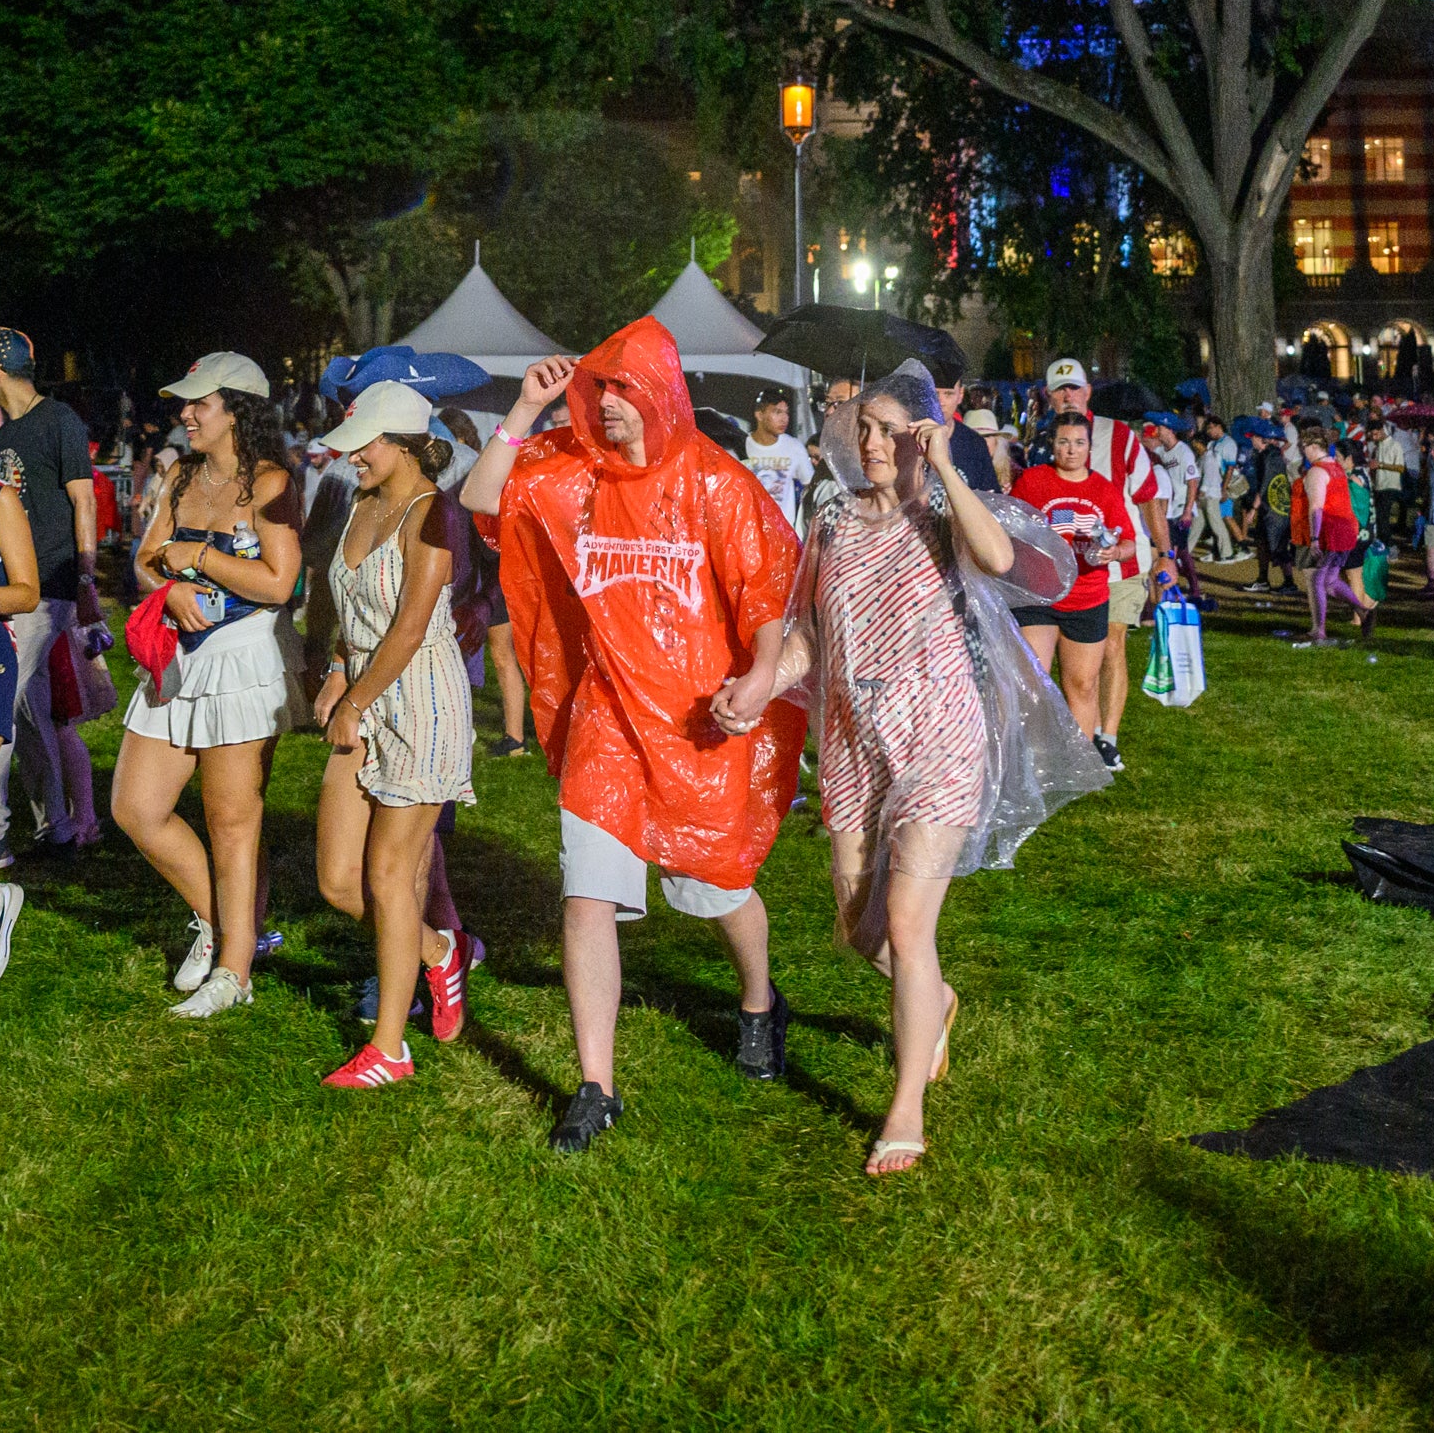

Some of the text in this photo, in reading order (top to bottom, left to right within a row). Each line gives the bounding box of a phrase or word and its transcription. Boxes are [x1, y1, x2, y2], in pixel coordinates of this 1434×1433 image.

[1055, 364, 1074, 375] 47
[645, 543, 672, 555] FIRST
[674, 546, 700, 557] STOP
[581, 551, 695, 602] MAVERIK
